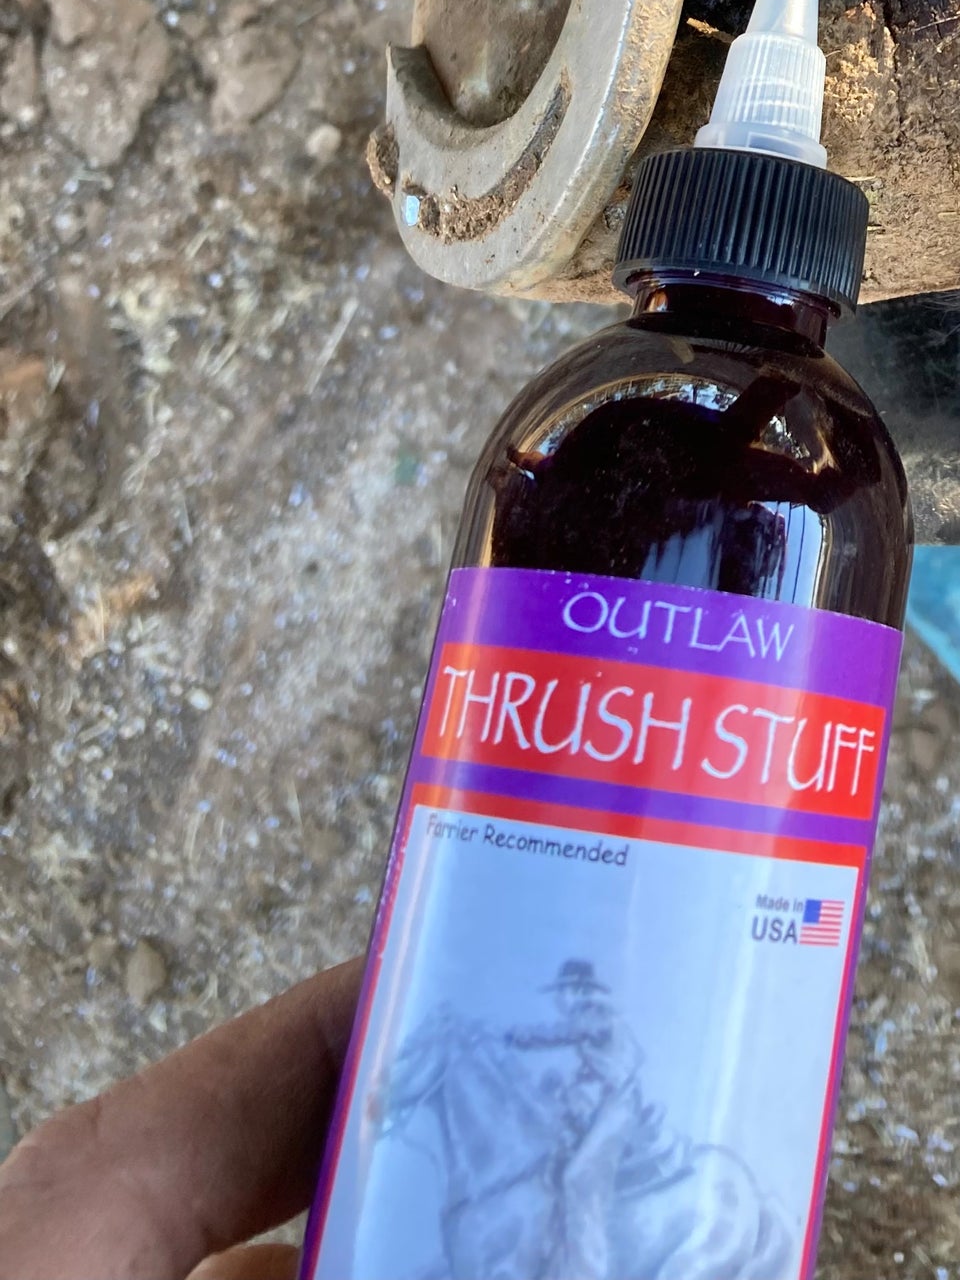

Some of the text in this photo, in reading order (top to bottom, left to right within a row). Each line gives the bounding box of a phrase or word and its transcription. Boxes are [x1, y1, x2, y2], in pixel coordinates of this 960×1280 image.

[562, 591, 795, 662] OUTLAW
[438, 665, 876, 796] THRUSH STUFF
[426, 813, 630, 867] Farrier Recommended
[755, 893, 790, 912] Made
[751, 915, 798, 945] USA
